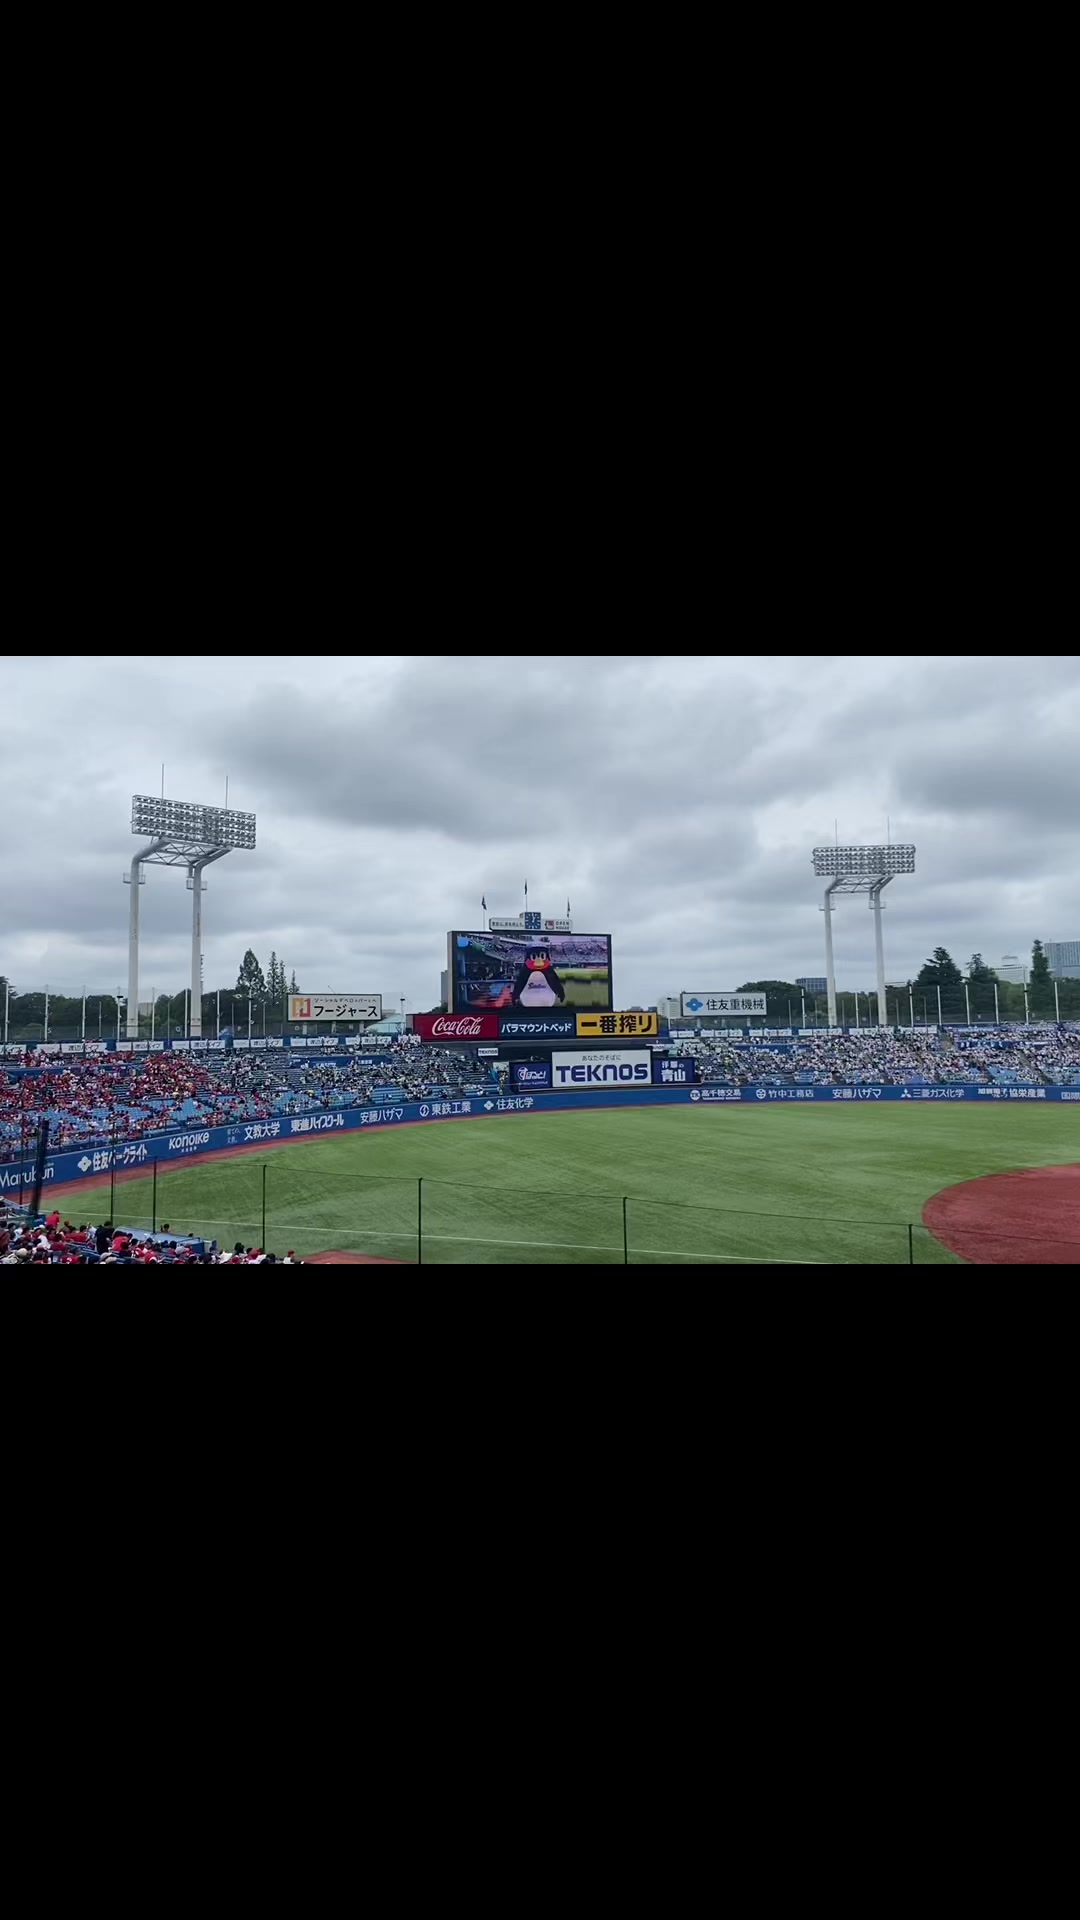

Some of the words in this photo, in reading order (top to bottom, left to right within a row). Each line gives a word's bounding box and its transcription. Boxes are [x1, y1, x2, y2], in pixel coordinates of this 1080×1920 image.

[314, 1004, 378, 1017] フージャース
[706, 998, 764, 1011] 住友重機械
[432, 1016, 483, 1036] Coca-Cola
[501, 1023, 572, 1033] パラマウントベッド
[581, 1015, 652, 1033] 一番搾り
[556, 1063, 648, 1083] TEKNOS
[661, 1069, 686, 1082] 青山
[701, 1089, 741, 1097] 高千穂交易
[768, 1089, 814, 1098] 竹中工務店
[832, 1088, 882, 1099] 安藤ハザマ
[912, 1089, 965, 1098] 三菱ガス化学
[1009, 1088, 1046, 1098] 協栄産業
[431, 1101, 472, 1116] 東鉄工業
[496, 1096, 534, 1110] 住友化学
[360, 1108, 404, 1124] 安藤ハザマ
[290, 1113, 345, 1133] 東進ハイスクール
[244, 1121, 281, 1141] 文教大学
